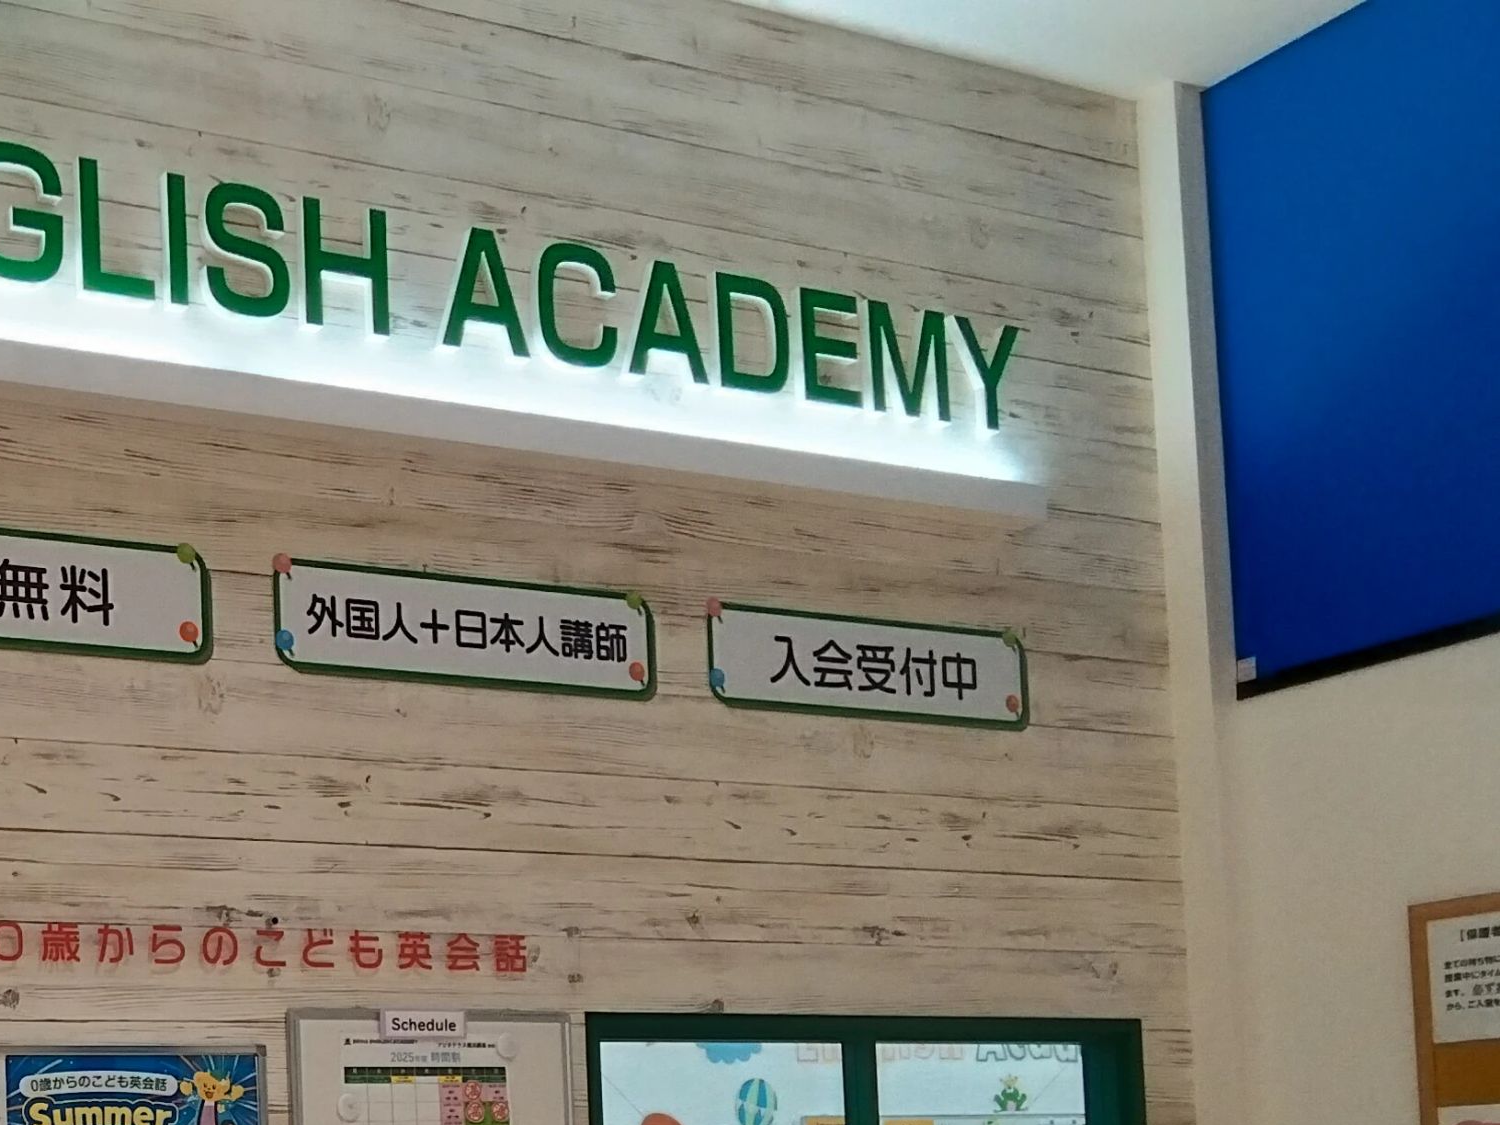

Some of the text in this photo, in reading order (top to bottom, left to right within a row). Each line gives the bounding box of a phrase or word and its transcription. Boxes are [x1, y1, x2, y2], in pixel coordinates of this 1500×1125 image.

[443, 227, 1019, 432] ACADEMY
[768, 634, 979, 701] 入会受付中
[392, 1018, 457, 1032] Schedule
